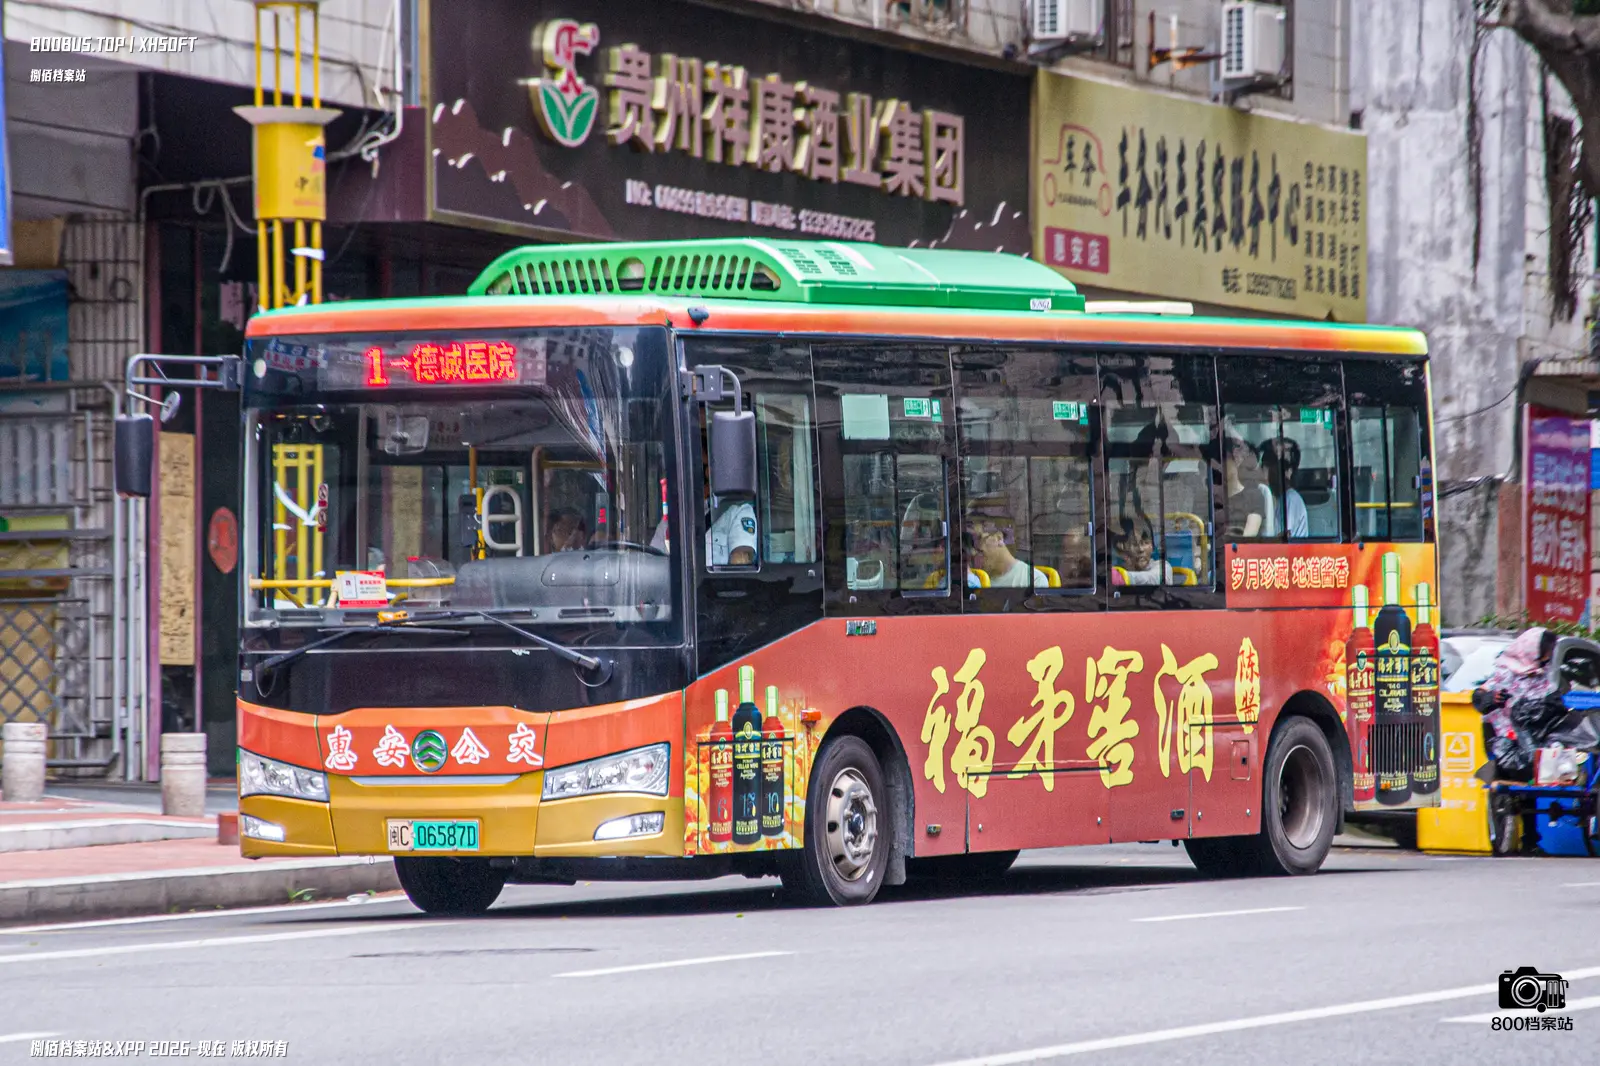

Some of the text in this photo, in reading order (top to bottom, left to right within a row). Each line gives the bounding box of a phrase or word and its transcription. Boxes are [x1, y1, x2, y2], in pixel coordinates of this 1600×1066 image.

[605, 43, 965, 206] 贵州祥康酒业集团
[366, 348, 388, 387] 1
[412, 341, 518, 382] 德诚医院
[1231, 556, 1349, 590] 岁月珍藏 地道酱香
[920, 643, 1220, 800] 福矛窖酒
[325, 723, 544, 771] 惠安公交
[417, 825, 476, 846] 06587D
